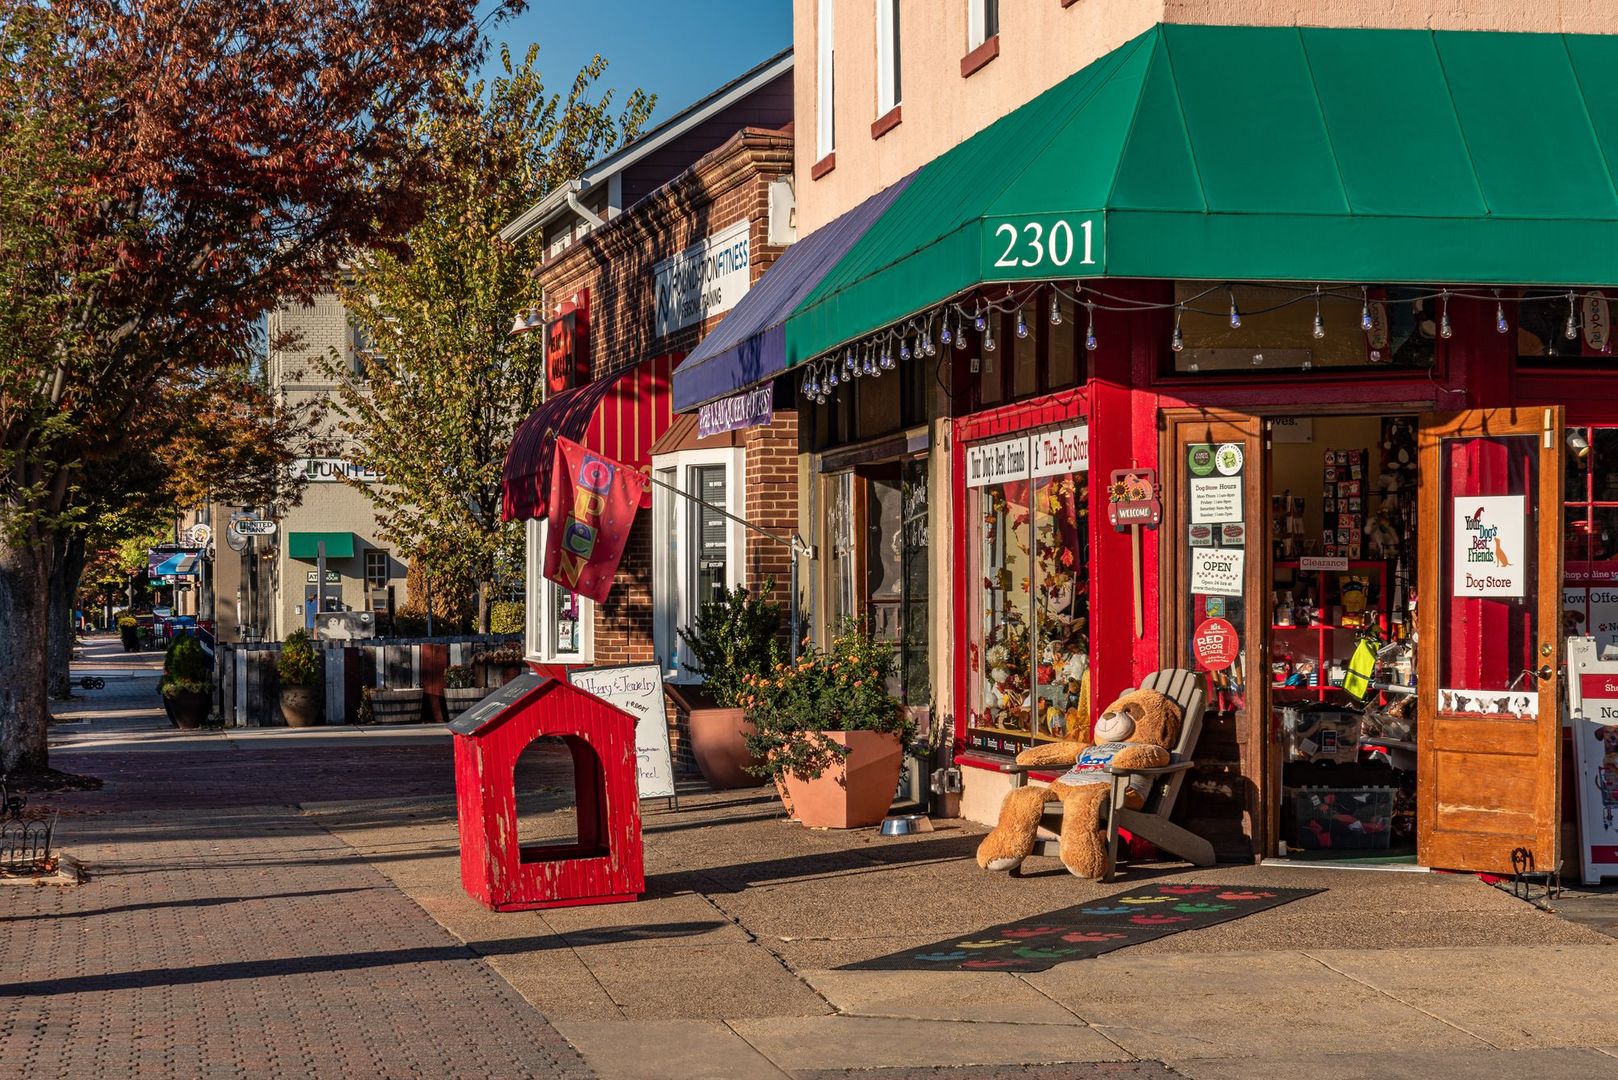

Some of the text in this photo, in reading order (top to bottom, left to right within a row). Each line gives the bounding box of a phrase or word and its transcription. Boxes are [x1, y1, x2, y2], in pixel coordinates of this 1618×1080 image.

[994, 219, 1096, 267] 2301
[702, 287, 722, 309] TRAINING
[1044, 435, 1088, 470] The Dog Stor
[982, 448, 994, 483] Dog's
[995, 447, 1006, 476] Best
[1007, 442, 1025, 474] Friends
[1119, 507, 1149, 518] WELCOME
[1464, 515, 1481, 530] Your
[1479, 524, 1498, 542] Dog's
[1472, 535, 1488, 550] Best
[1467, 547, 1494, 563] Friends
[1203, 560, 1232, 572] OPEN
[1301, 559, 1346, 567] Clearance
[1583, 570, 1610, 578] oline
[1465, 575, 1512, 591] Dog Store
[1196, 634, 1224, 647] RED
[1199, 643, 1223, 653] DOOR
[1200, 649, 1223, 657] RETAILER
[638, 766, 660, 779] heel
